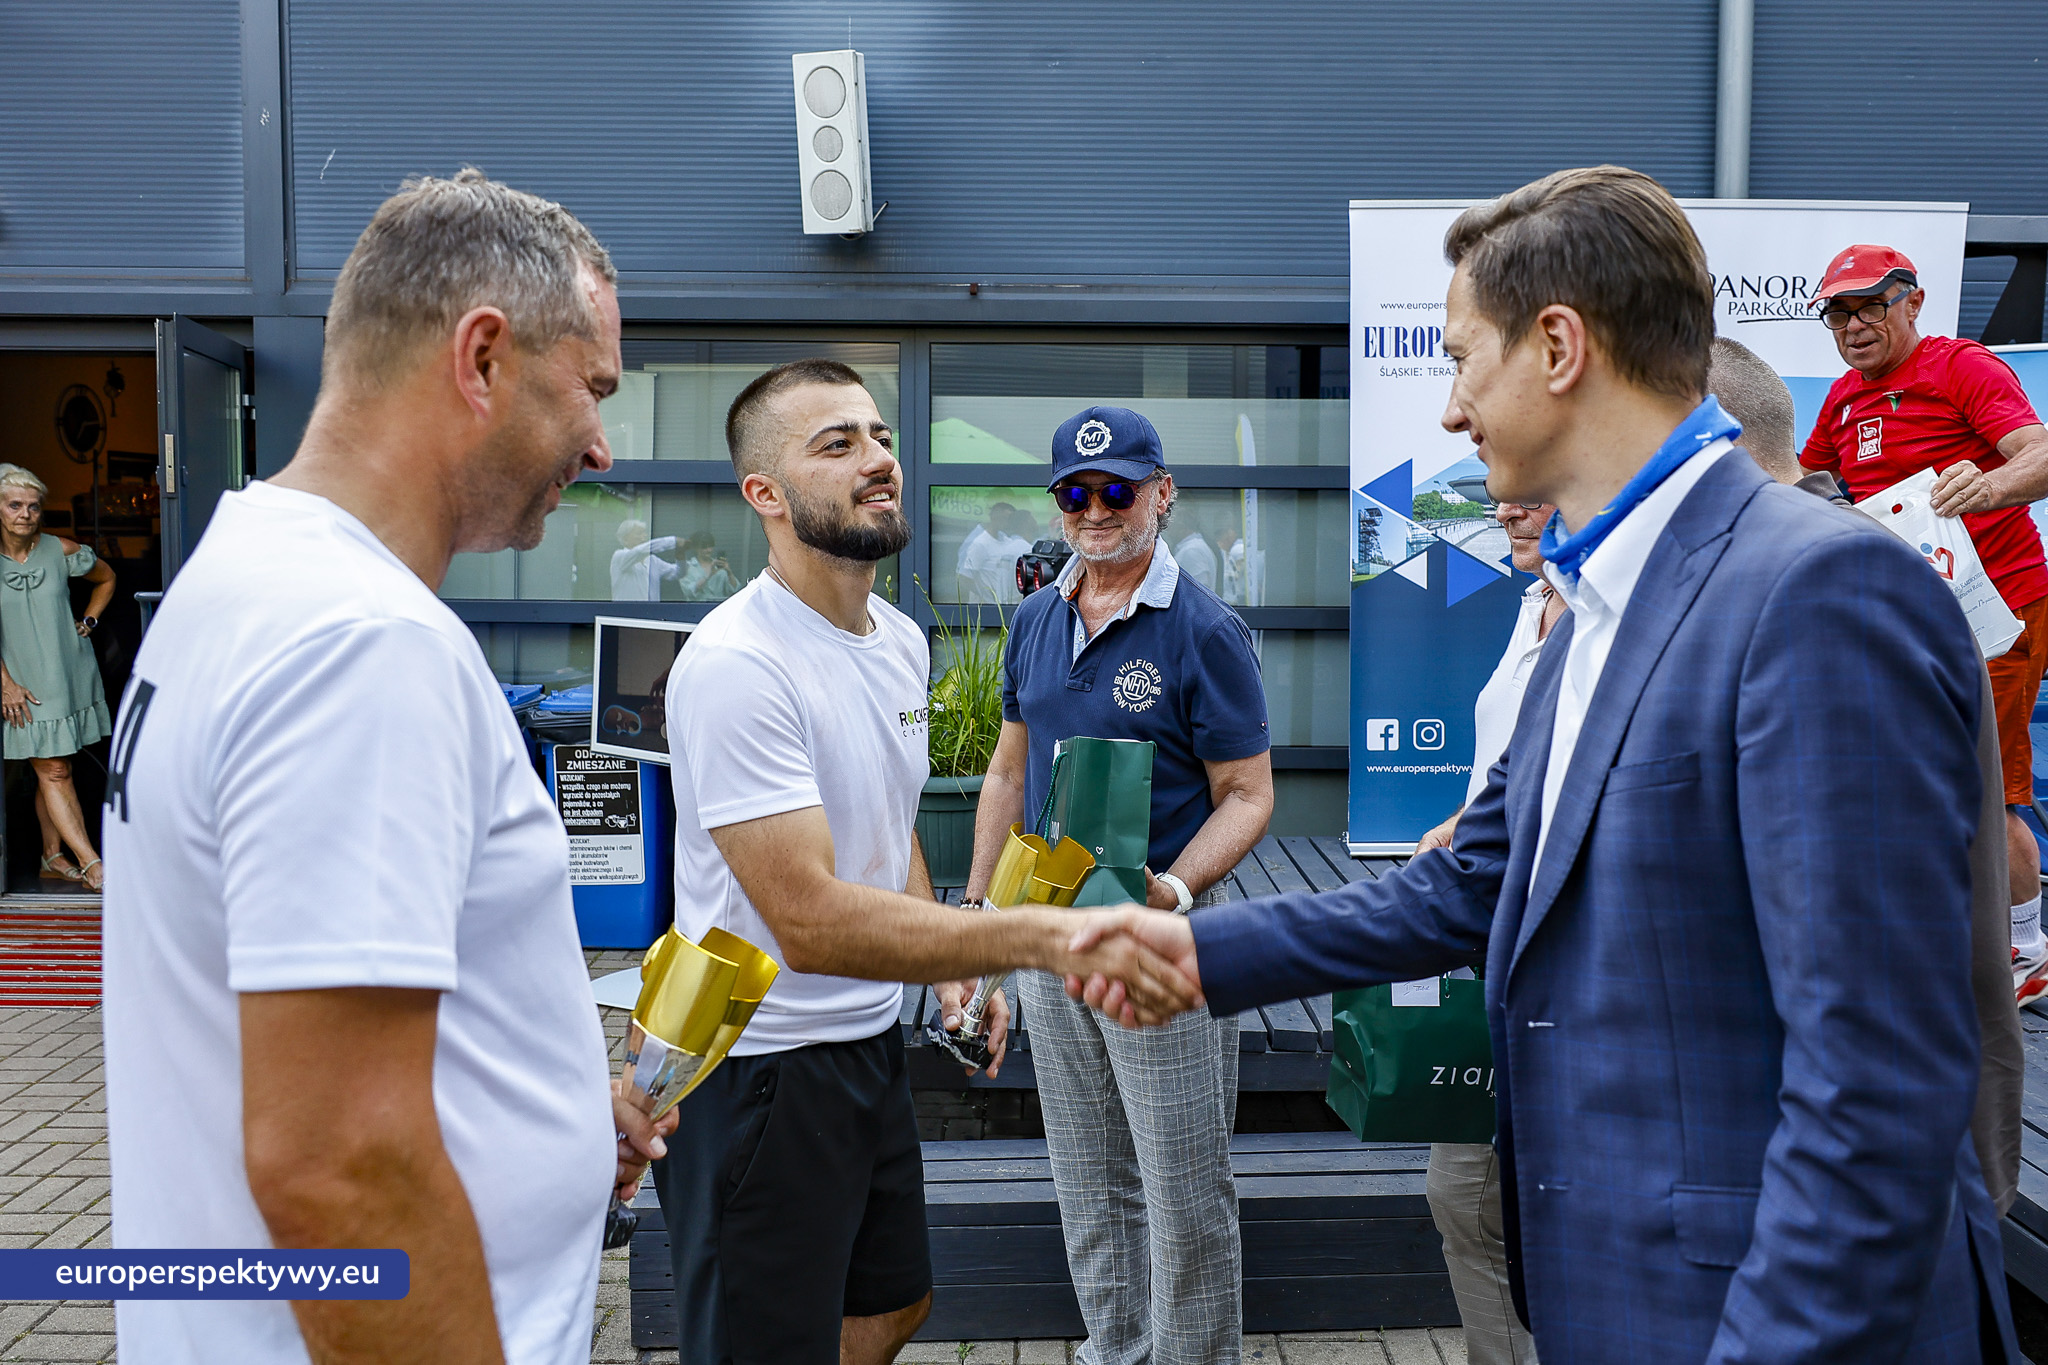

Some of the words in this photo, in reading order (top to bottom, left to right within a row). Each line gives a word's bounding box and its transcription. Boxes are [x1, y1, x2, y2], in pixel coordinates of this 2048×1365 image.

[1380, 302, 1447, 311] www.europers
[1363, 325, 1447, 359] EUROP
[1118, 659, 1162, 685] HILFIGER
[1112, 686, 1129, 709] NEW
[1128, 695, 1157, 713] YORK
[574, 749, 615, 759] ODPA
[566, 760, 627, 770] ZMIESZANE
[1366, 762, 1473, 775] www.europerspektywy
